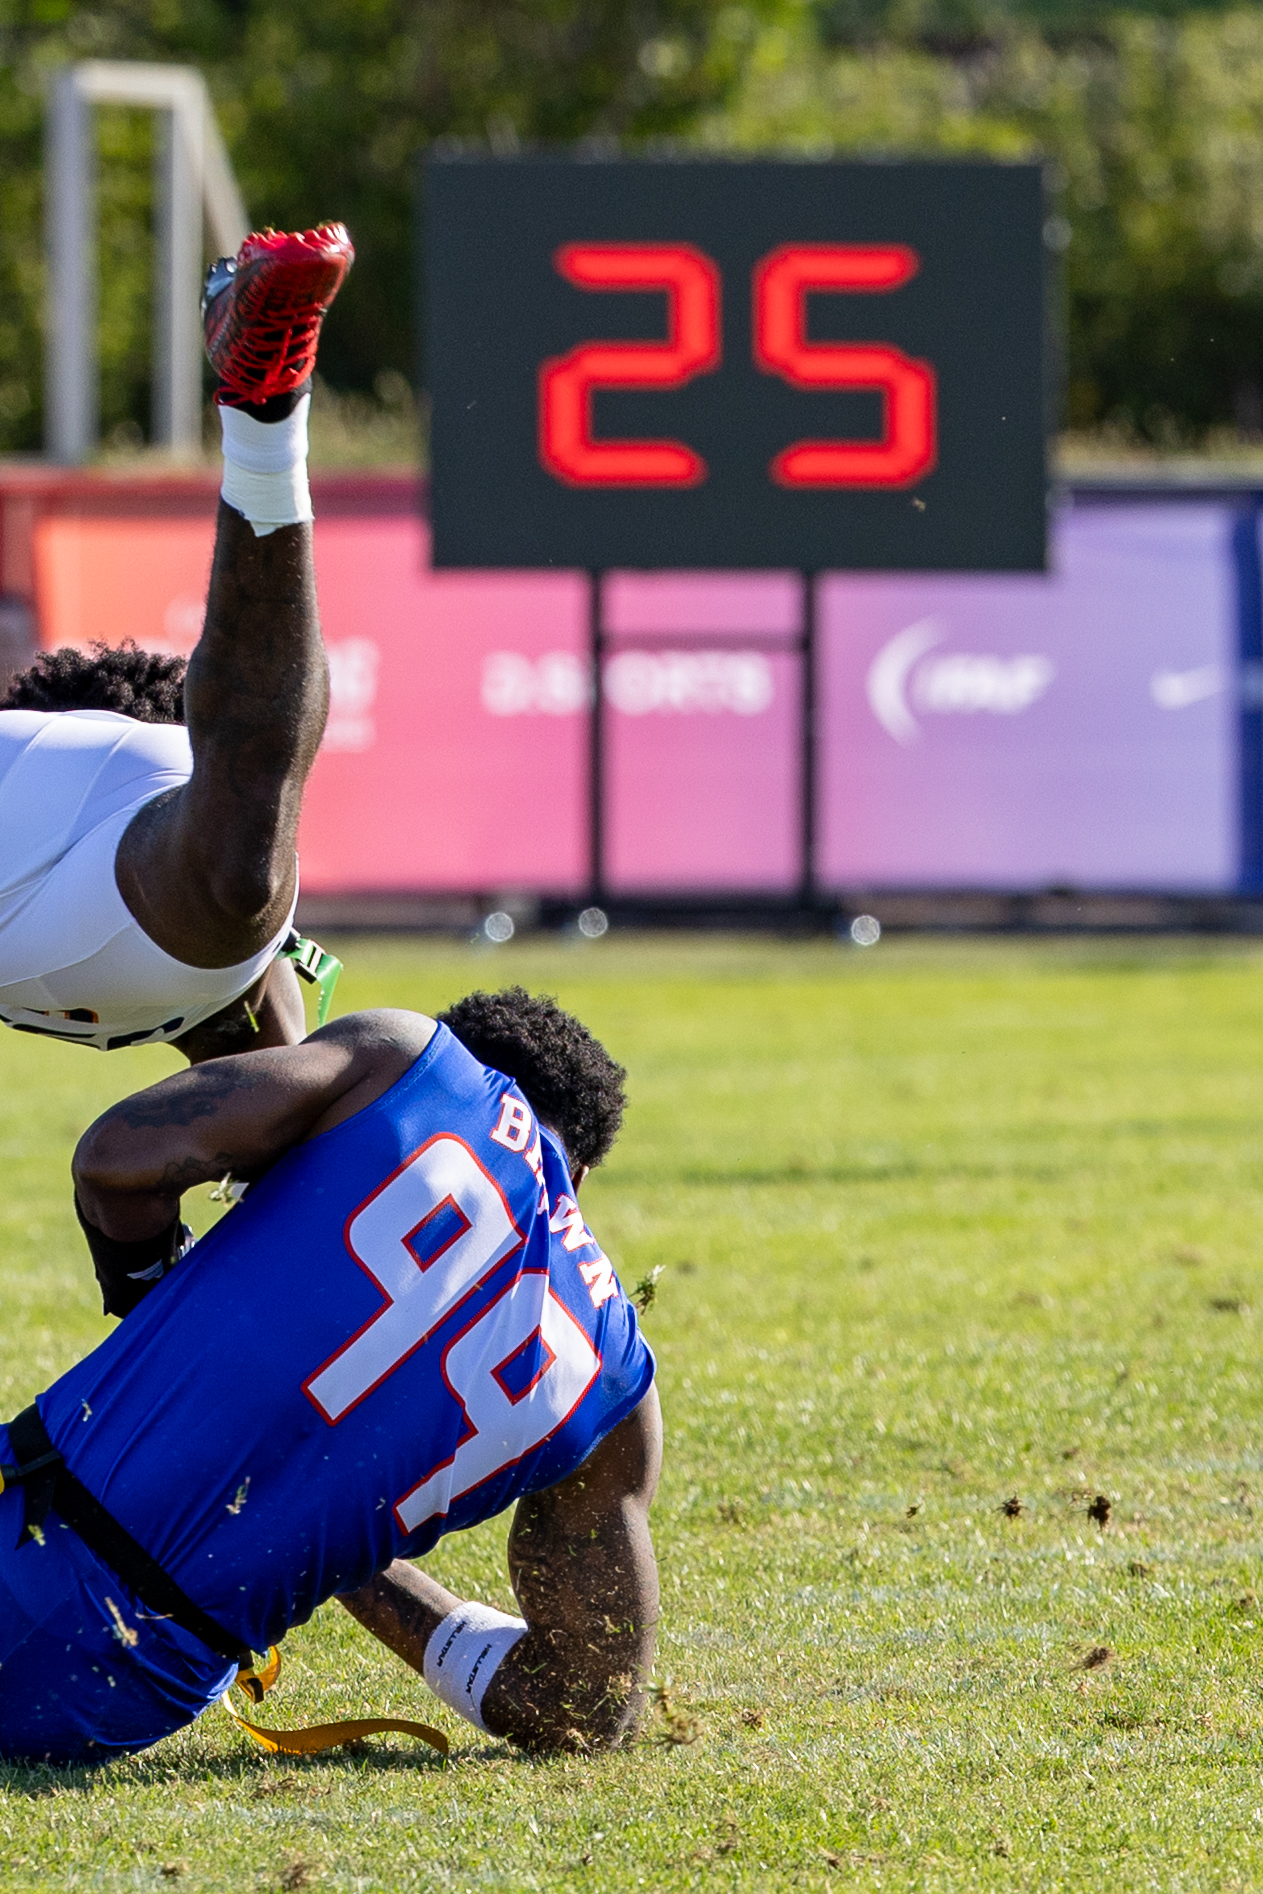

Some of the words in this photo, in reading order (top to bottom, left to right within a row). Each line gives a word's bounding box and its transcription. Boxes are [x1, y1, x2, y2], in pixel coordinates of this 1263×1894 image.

[540, 242, 936, 489] 25
[491, 1093, 618, 1310] BWN
[301, 1132, 603, 1535] 99
